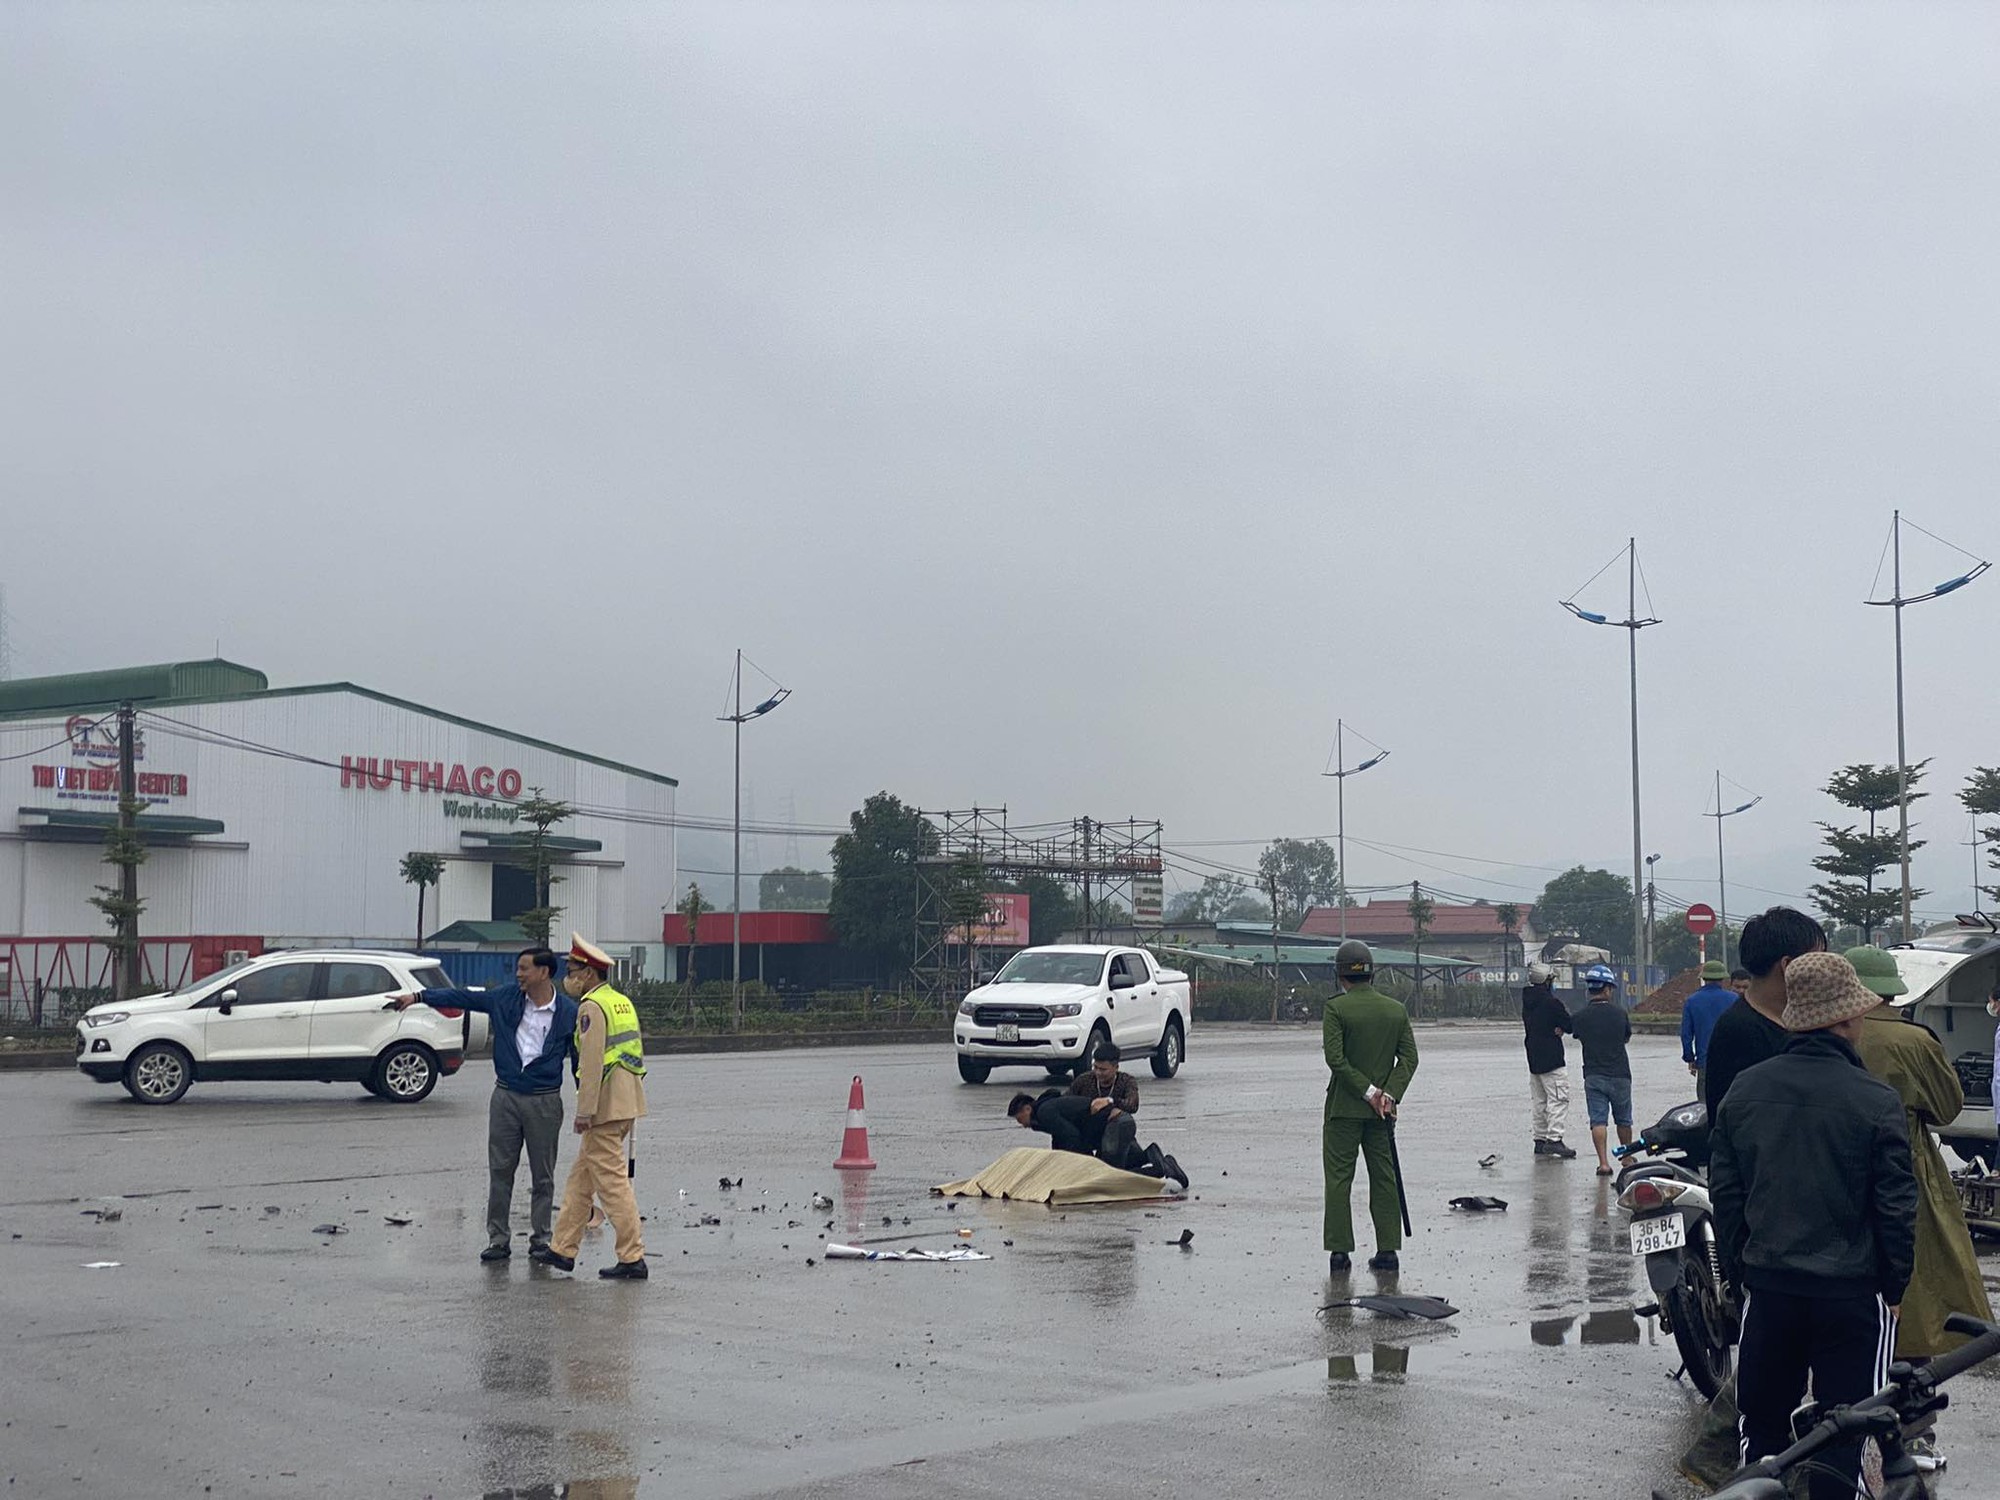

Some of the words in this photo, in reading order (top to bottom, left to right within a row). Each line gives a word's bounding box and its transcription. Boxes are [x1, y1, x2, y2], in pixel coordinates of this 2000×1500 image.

[341, 755, 522, 797] HUTHACO
[443, 799, 520, 824] Workshop
[1639, 1217, 1674, 1237] 36-B4
[1636, 1230, 1680, 1253] 298.47
